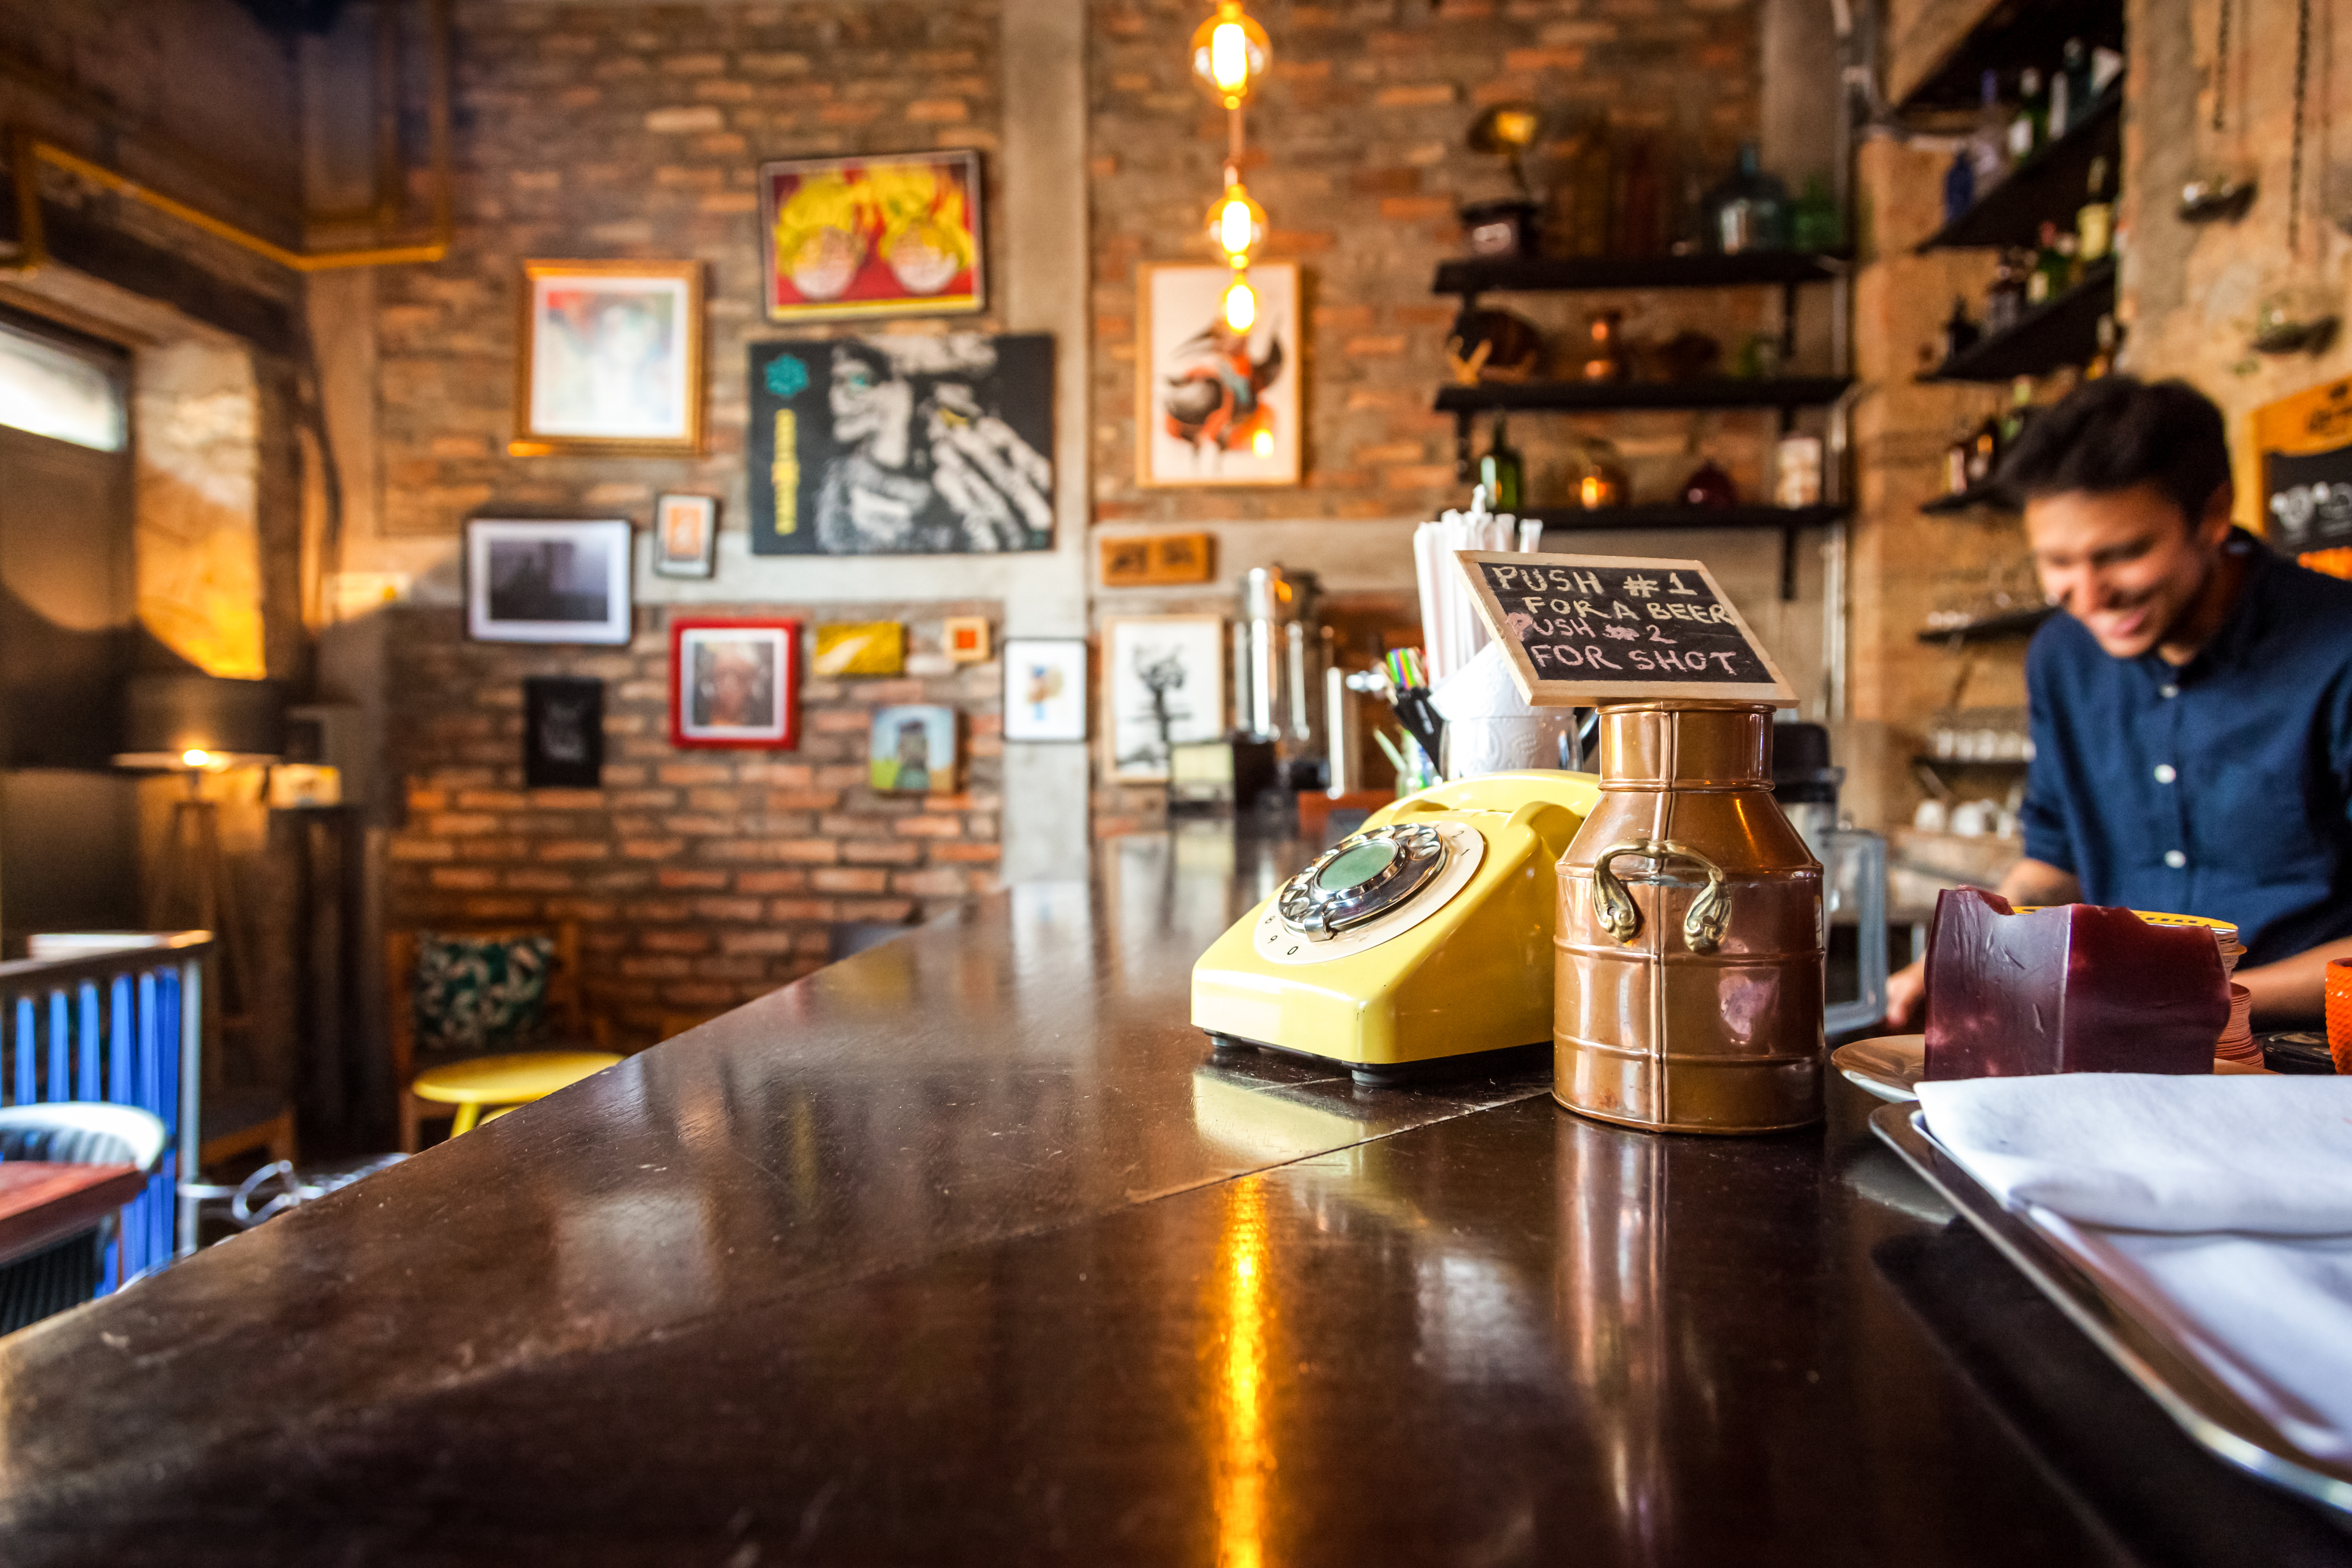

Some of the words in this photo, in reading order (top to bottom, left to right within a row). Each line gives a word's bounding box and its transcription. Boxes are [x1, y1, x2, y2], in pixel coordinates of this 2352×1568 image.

[1492, 566, 1605, 595] PUSH
[1522, 597, 1612, 618] FOR
[1613, 600, 1640, 620] A
[1646, 603, 1736, 626] BEER
[1531, 645, 1623, 670] FOR
[1628, 650, 1738, 676] SHOT
[1265, 916, 1276, 924] 8
[1267, 935, 1278, 944] 9
[1287, 946, 1299, 955] 0
